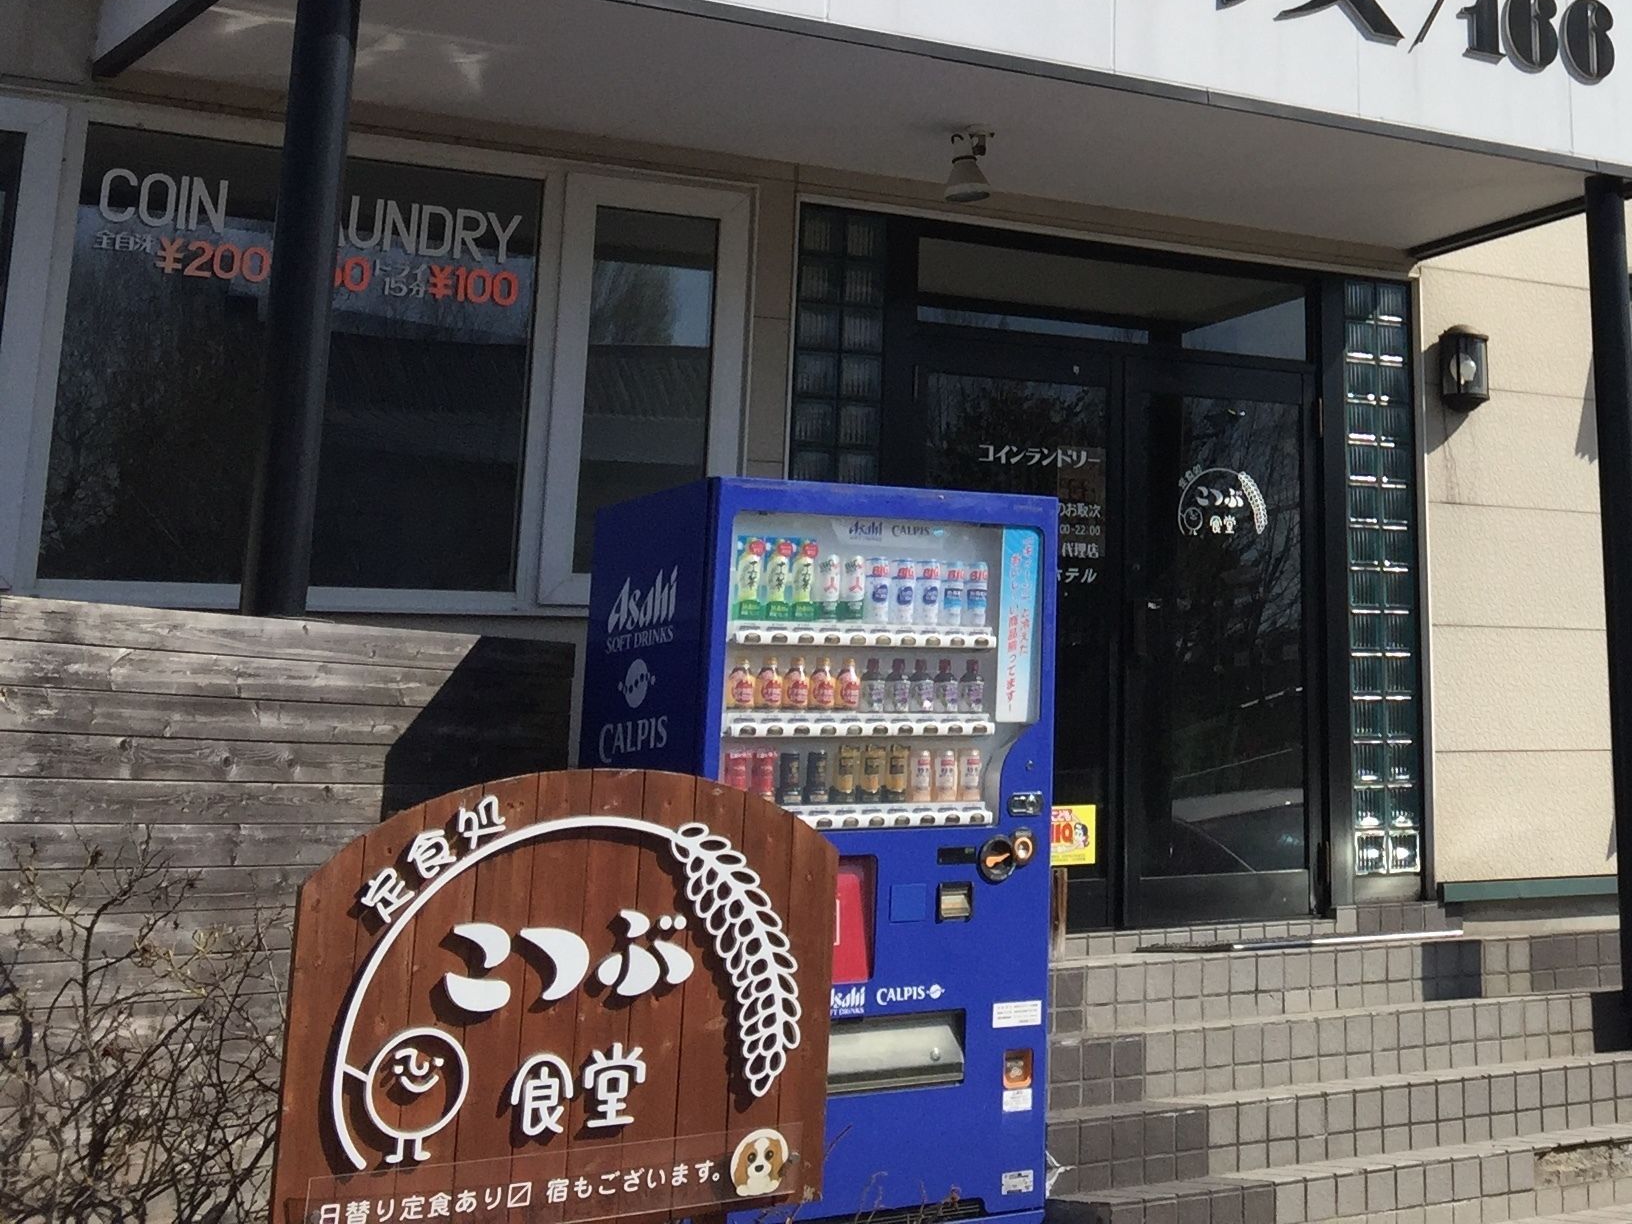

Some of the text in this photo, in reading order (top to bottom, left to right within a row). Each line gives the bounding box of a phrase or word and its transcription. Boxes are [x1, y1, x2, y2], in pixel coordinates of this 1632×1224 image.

[98, 167, 523, 264] COIN UNDRY
[155, 235, 272, 283] ¥200
[428, 263, 519, 307] ¥100
[978, 443, 1101, 470] コインランドリー
[1195, 486, 1245, 509] こつぶ
[849, 521, 931, 537] Asahi CALPIS
[607, 564, 679, 634] Asahi
[604, 625, 675, 655] SOFT DRINKS
[599, 715, 668, 764] CALPIS
[361, 794, 506, 923] 定食処
[443, 908, 695, 1012] こつぶ
[876, 985, 926, 1006] CALPIS
[510, 1042, 647, 1137] 食堂
